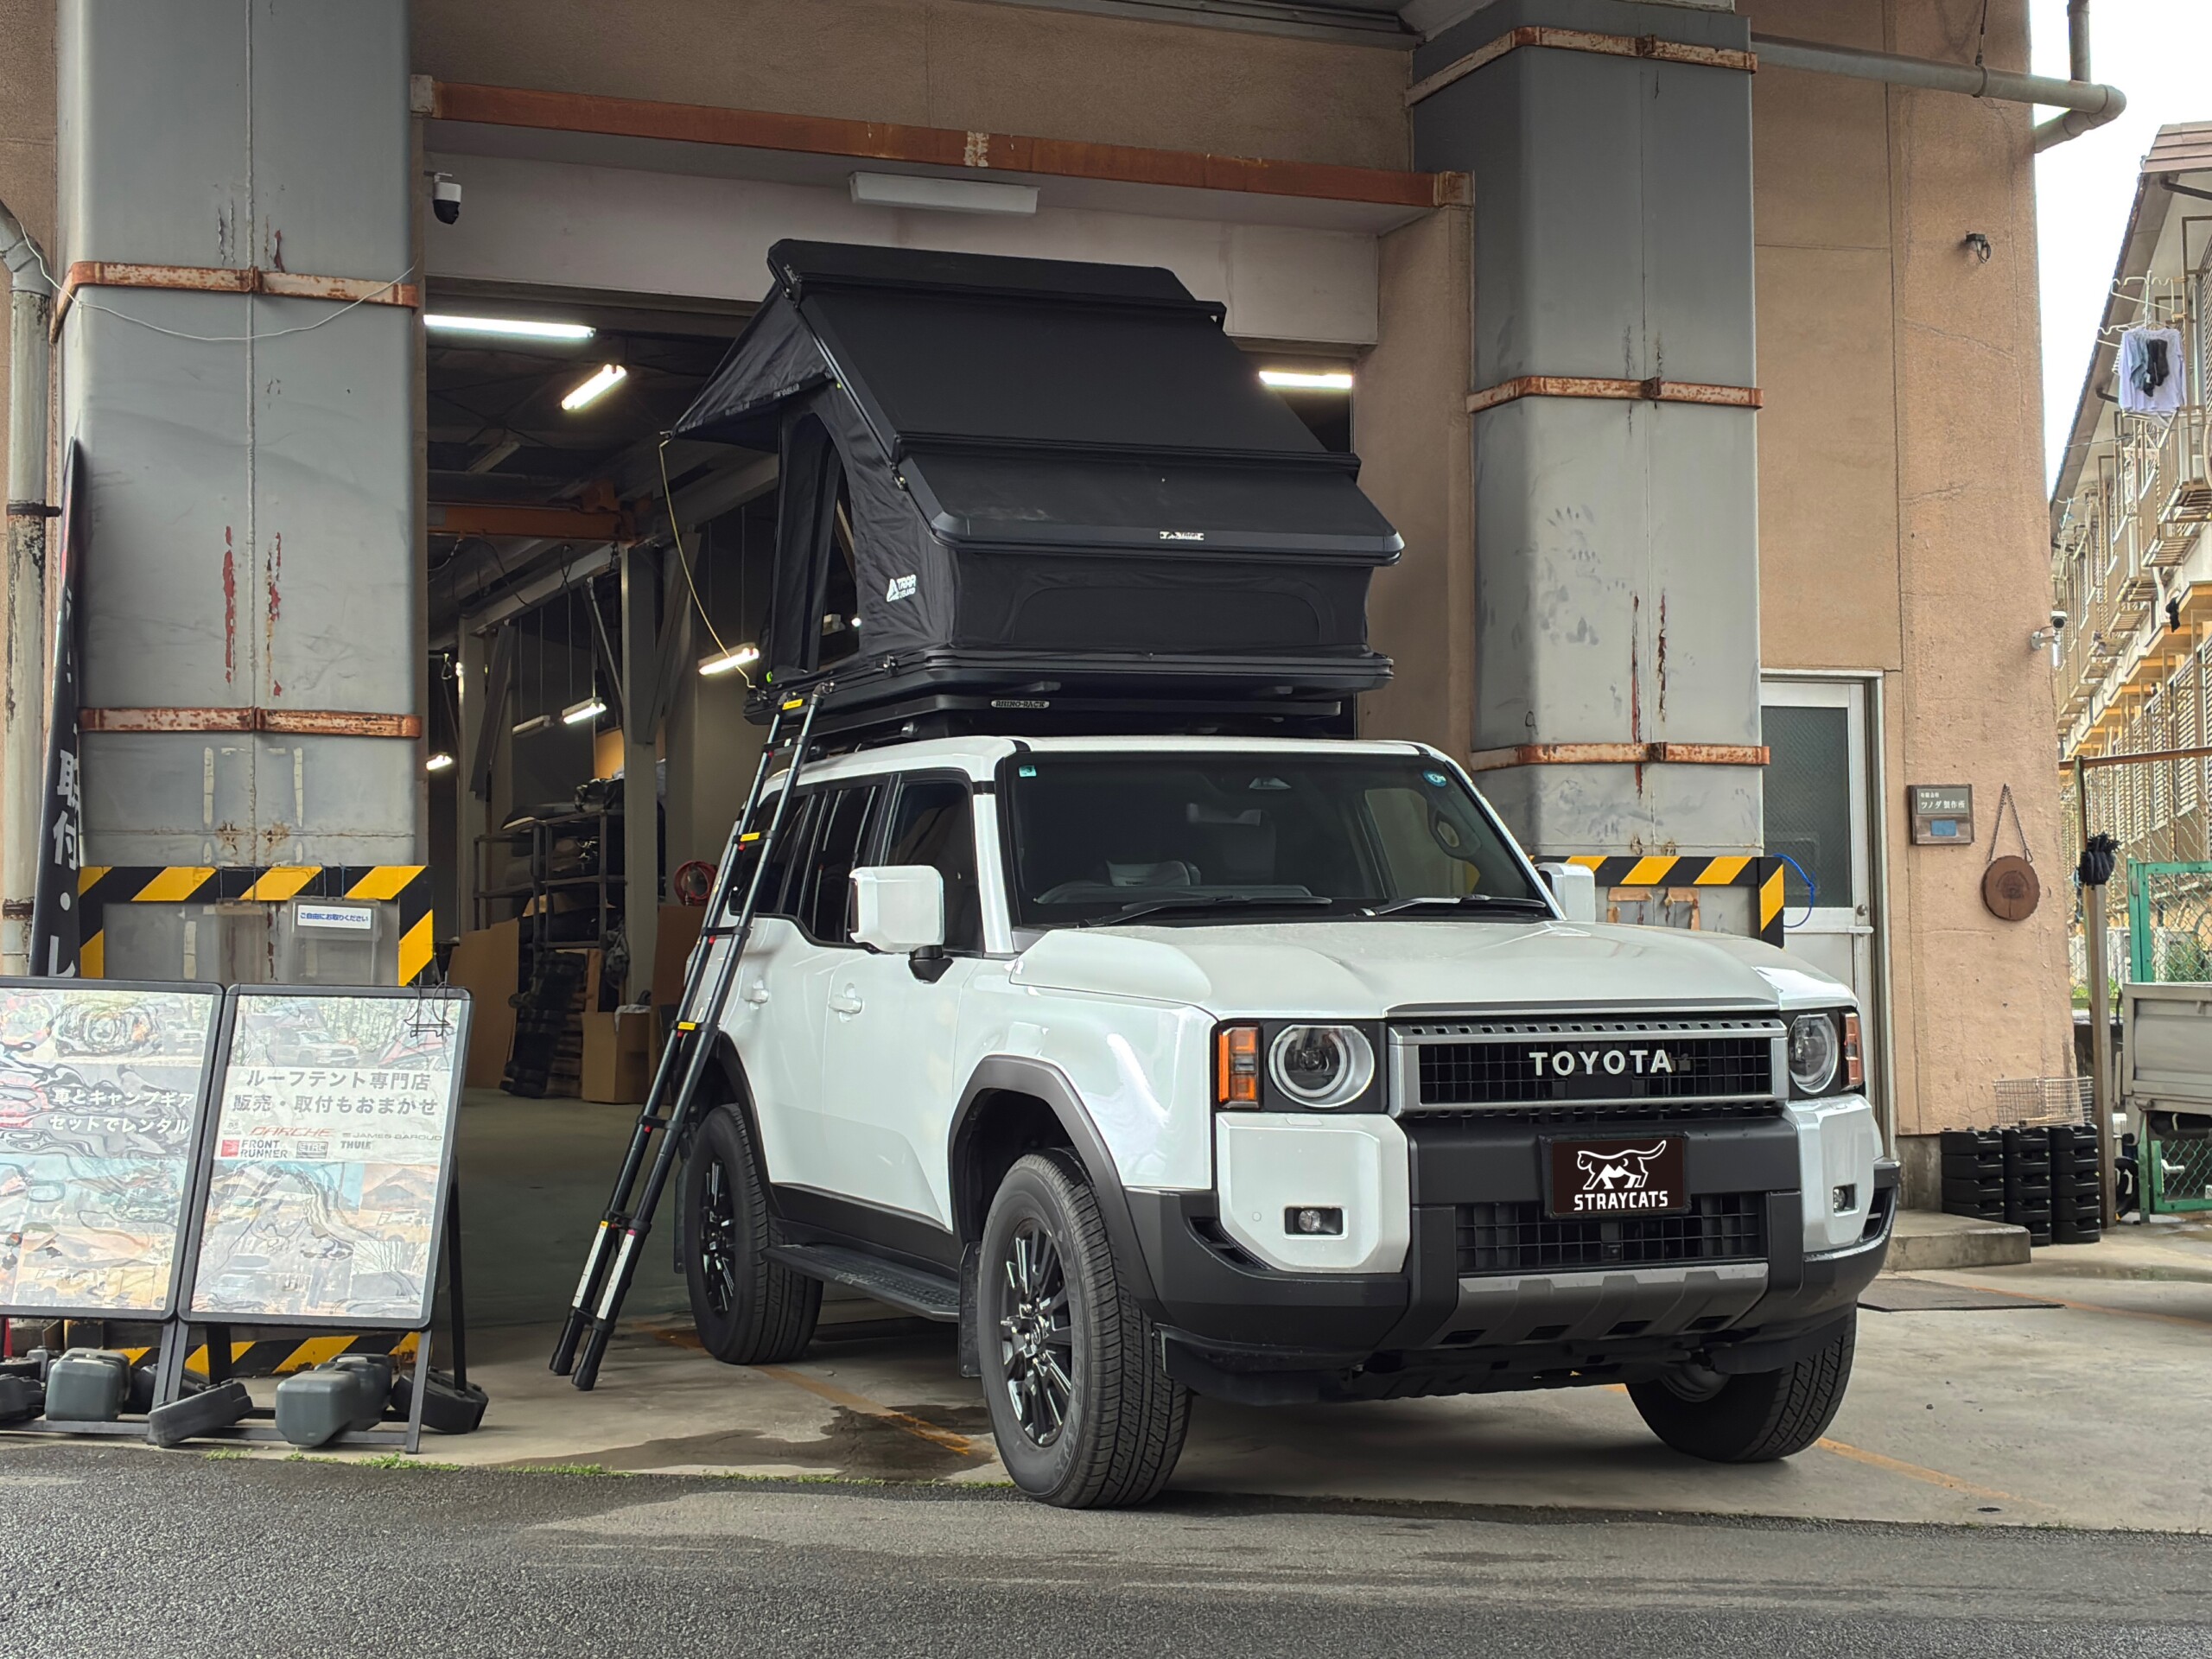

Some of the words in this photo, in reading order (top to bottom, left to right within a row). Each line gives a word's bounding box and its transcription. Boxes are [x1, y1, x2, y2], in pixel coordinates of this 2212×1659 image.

[300, 912, 369, 922] ご自由にお取りください
[1529, 1049, 1673, 1077] TOYOTA
[246, 1070, 431, 1091] ルーフテント専門店
[53, 1088, 195, 1109] 車とキャンプギア
[232, 1094, 438, 1116] 販売・取付もおまかせ
[48, 1115, 191, 1135] セットでレンタル
[249, 1126, 335, 1137] DARCHE
[240, 1149, 288, 1159] RUNNER
[242, 1140, 281, 1148] FRONT
[340, 1141, 372, 1149] THULE
[1573, 1190, 1669, 1211] STRAYCATS
